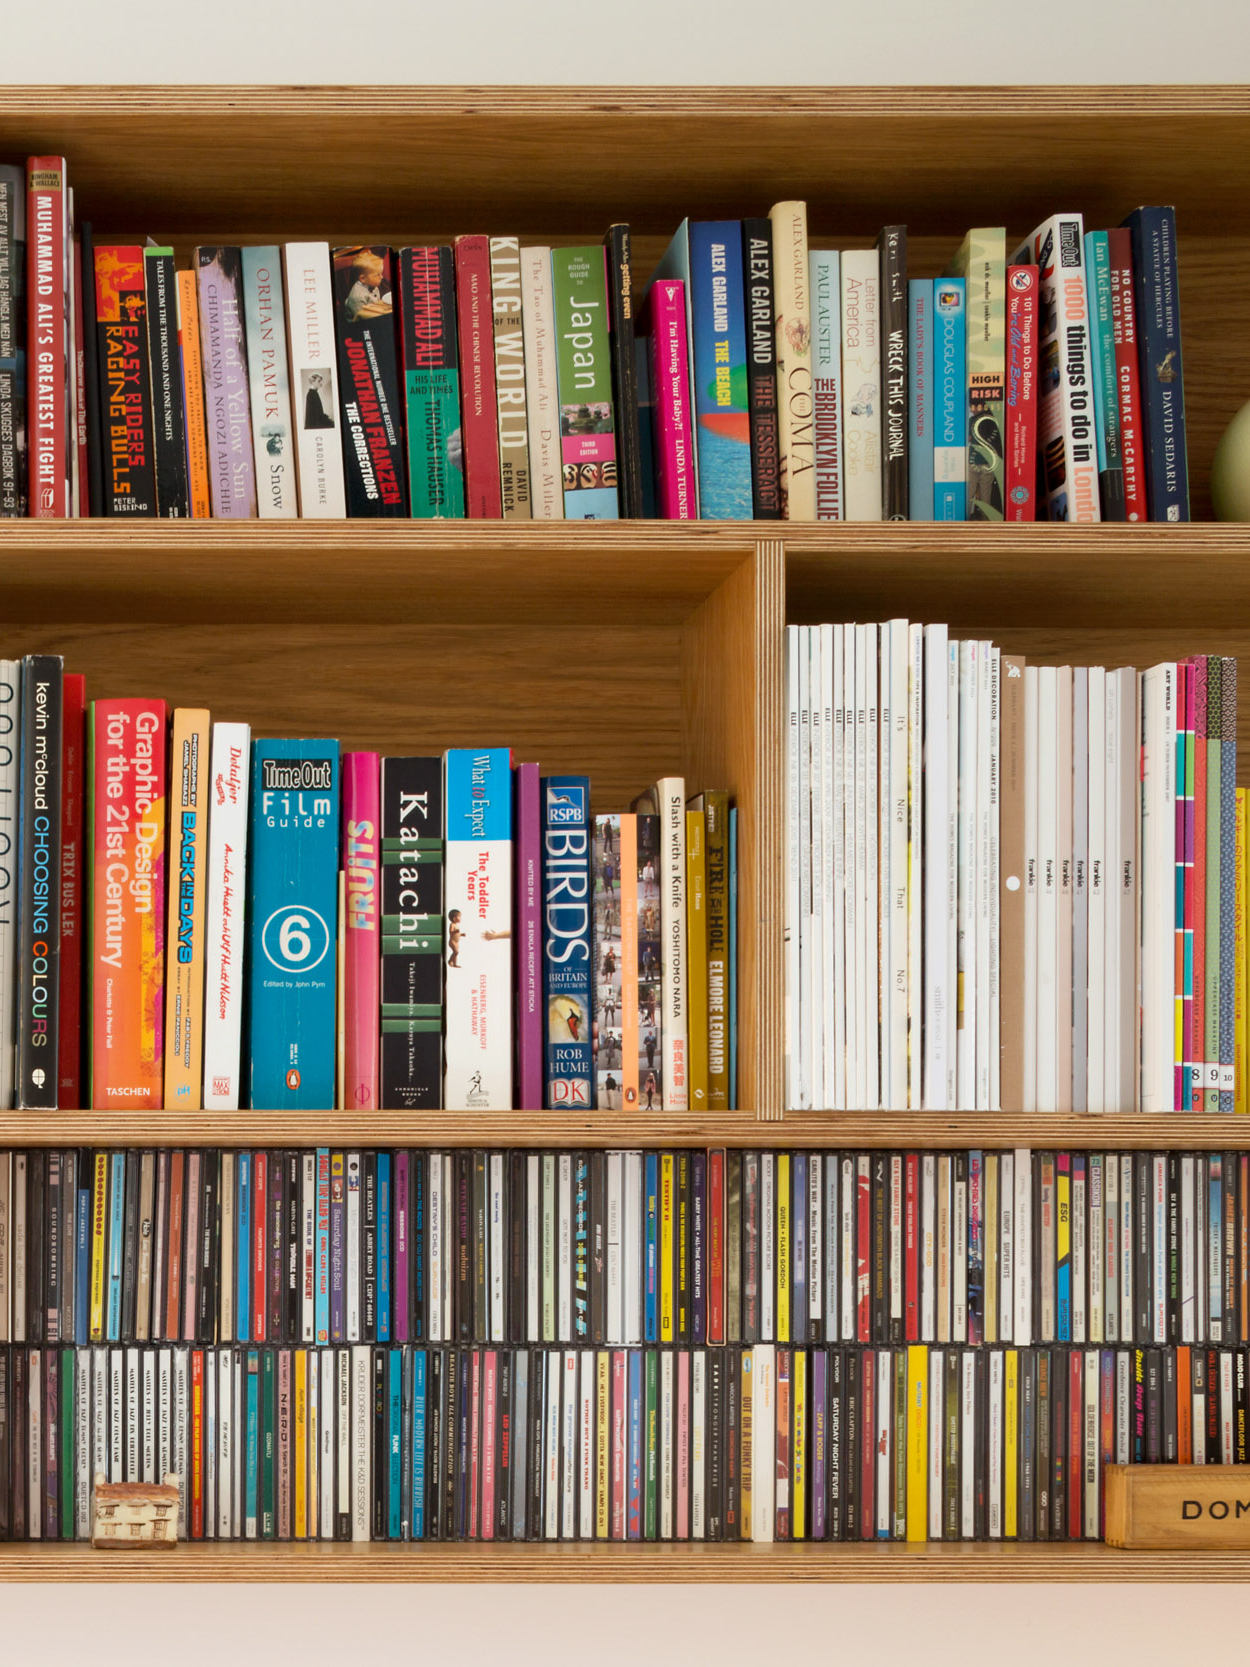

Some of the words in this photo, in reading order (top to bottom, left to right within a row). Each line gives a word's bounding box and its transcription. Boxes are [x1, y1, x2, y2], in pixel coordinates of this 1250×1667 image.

[37, 196, 53, 295] MUHAMMAD
[711, 244, 726, 272] ALEX
[412, 248, 443, 339] MUHAMMAD
[490, 237, 522, 313] KING
[1064, 275, 1085, 320] 1000
[222, 299, 240, 342] Half
[257, 268, 272, 340] ORHAN
[713, 277, 728, 332] GARLAND
[121, 326, 140, 384] EASY
[224, 348, 242, 368] of
[416, 343, 444, 365] ALI
[564, 297, 599, 389] Japan
[670, 340, 679, 373] Having
[715, 340, 729, 362] THE
[888, 330, 902, 372] WRECK
[1066, 325, 1087, 386] things
[0, 374, 12, 398] LINDA
[38, 353, 54, 429] GREATEST
[106, 326, 126, 416] RAGING
[263, 350, 278, 418] PAMUK
[494, 331, 527, 447] WORLD
[672, 376, 681, 397] Your
[716, 367, 731, 406] BEACH
[814, 378, 835, 391] THE
[888, 376, 903, 405] THIS
[971, 375, 1000, 384] HIGH
[345, 402, 360, 423] THE
[972, 390, 999, 399] RISK
[1071, 391, 1088, 410] to
[1120, 366, 1132, 422] CORMAC
[1, 402, 13, 441] SKUGGES
[126, 393, 145, 466] RIDERS
[228, 387, 247, 453] Yellow
[344, 338, 381, 423] JONATHAN
[365, 427, 401, 504] FRANZEN
[425, 400, 442, 451] THOMAS
[789, 367, 814, 477] COMA
[815, 393, 838, 469] BROOKLYN
[888, 410, 904, 460] JOURNAL
[1072, 415, 1090, 439] do
[1, 444, 13, 479] DAGBOK
[40, 438, 55, 483] FIGHT
[110, 426, 130, 493] BULLS
[351, 426, 379, 499] CORRECTIONS
[1073, 445, 1092, 462] in
[1124, 430, 1136, 500] McCARTHY
[233, 463, 248, 498] Sun
[270, 465, 284, 509] Snow
[427, 457, 445, 505] HAUSER
[107, 712, 130, 749] for
[107, 755, 129, 798] the
[131, 712, 158, 814] Graphic
[471, 755, 489, 784] What
[263, 793, 330, 815] Film
[472, 787, 487, 798] to
[550, 808, 582, 821] RSPB
[106, 805, 130, 857] 21st
[267, 816, 325, 828] Guide
[465, 800, 489, 837] Expect
[33, 816, 49, 933] CHOOSING
[130, 822, 159, 912] Design
[398, 791, 428, 950] Katachi
[101, 863, 129, 968] Century
[545, 830, 589, 963] BIRDS
[279, 915, 311, 961] 6
[672, 919, 680, 984] YOSHITOMO
[32, 941, 47, 1046] COLOURS
[673, 988, 681, 1017] NARA
[709, 961, 724, 1012] ELMORE
[710, 1016, 724, 1073] LEONARD
[106, 1087, 150, 1096] TASCHEN
[553, 1082, 585, 1100] DK
[1192, 1069, 1200, 1081] 8
[1210, 1069, 1218, 1081] 9
